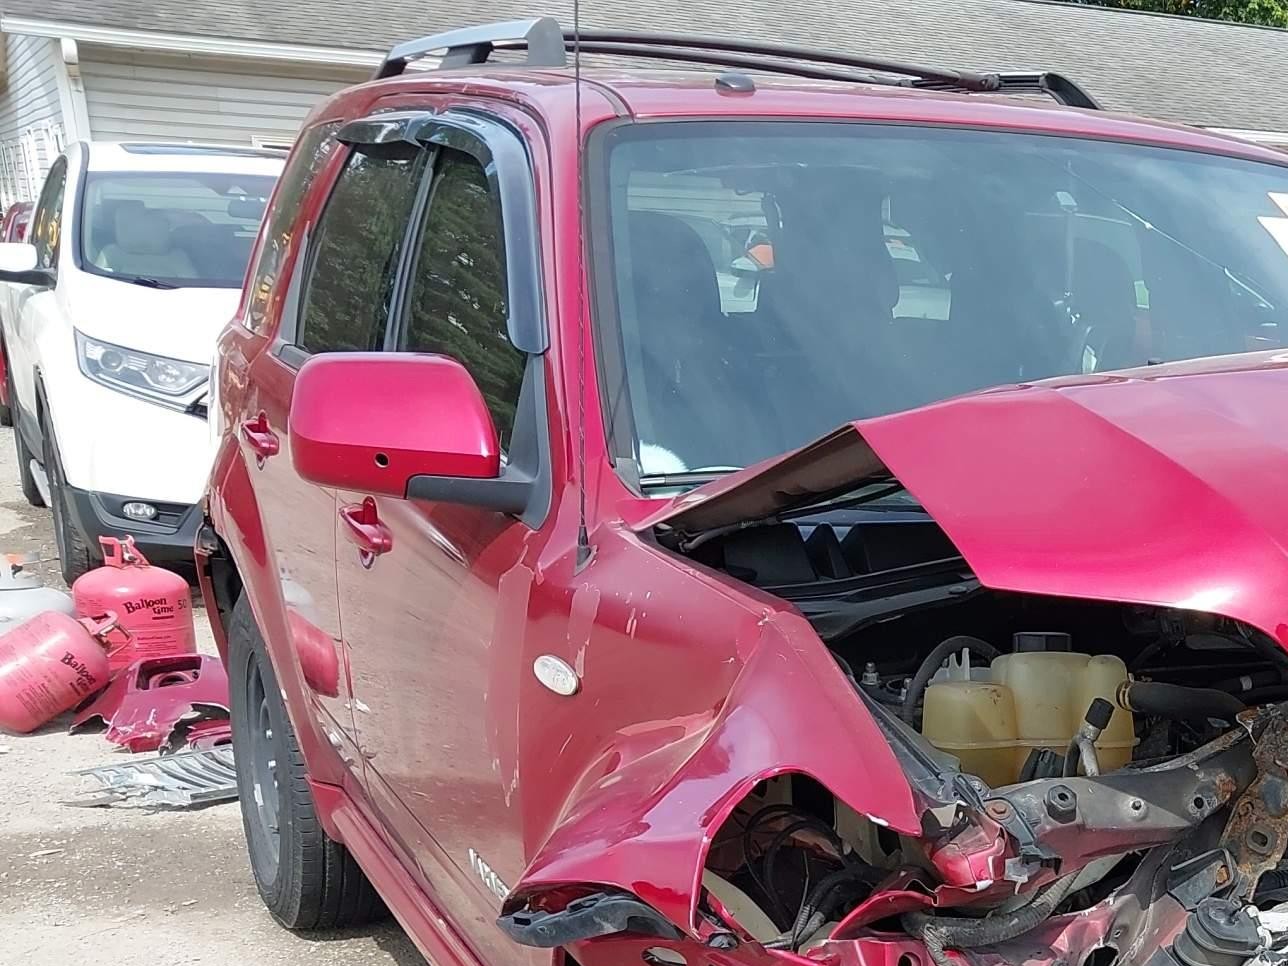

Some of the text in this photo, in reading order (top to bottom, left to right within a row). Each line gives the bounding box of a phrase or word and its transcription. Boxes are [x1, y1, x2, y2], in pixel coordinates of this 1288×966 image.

[123, 597, 167, 615] Balloon
[152, 605, 175, 615] time
[60, 650, 97, 686] Balloon
